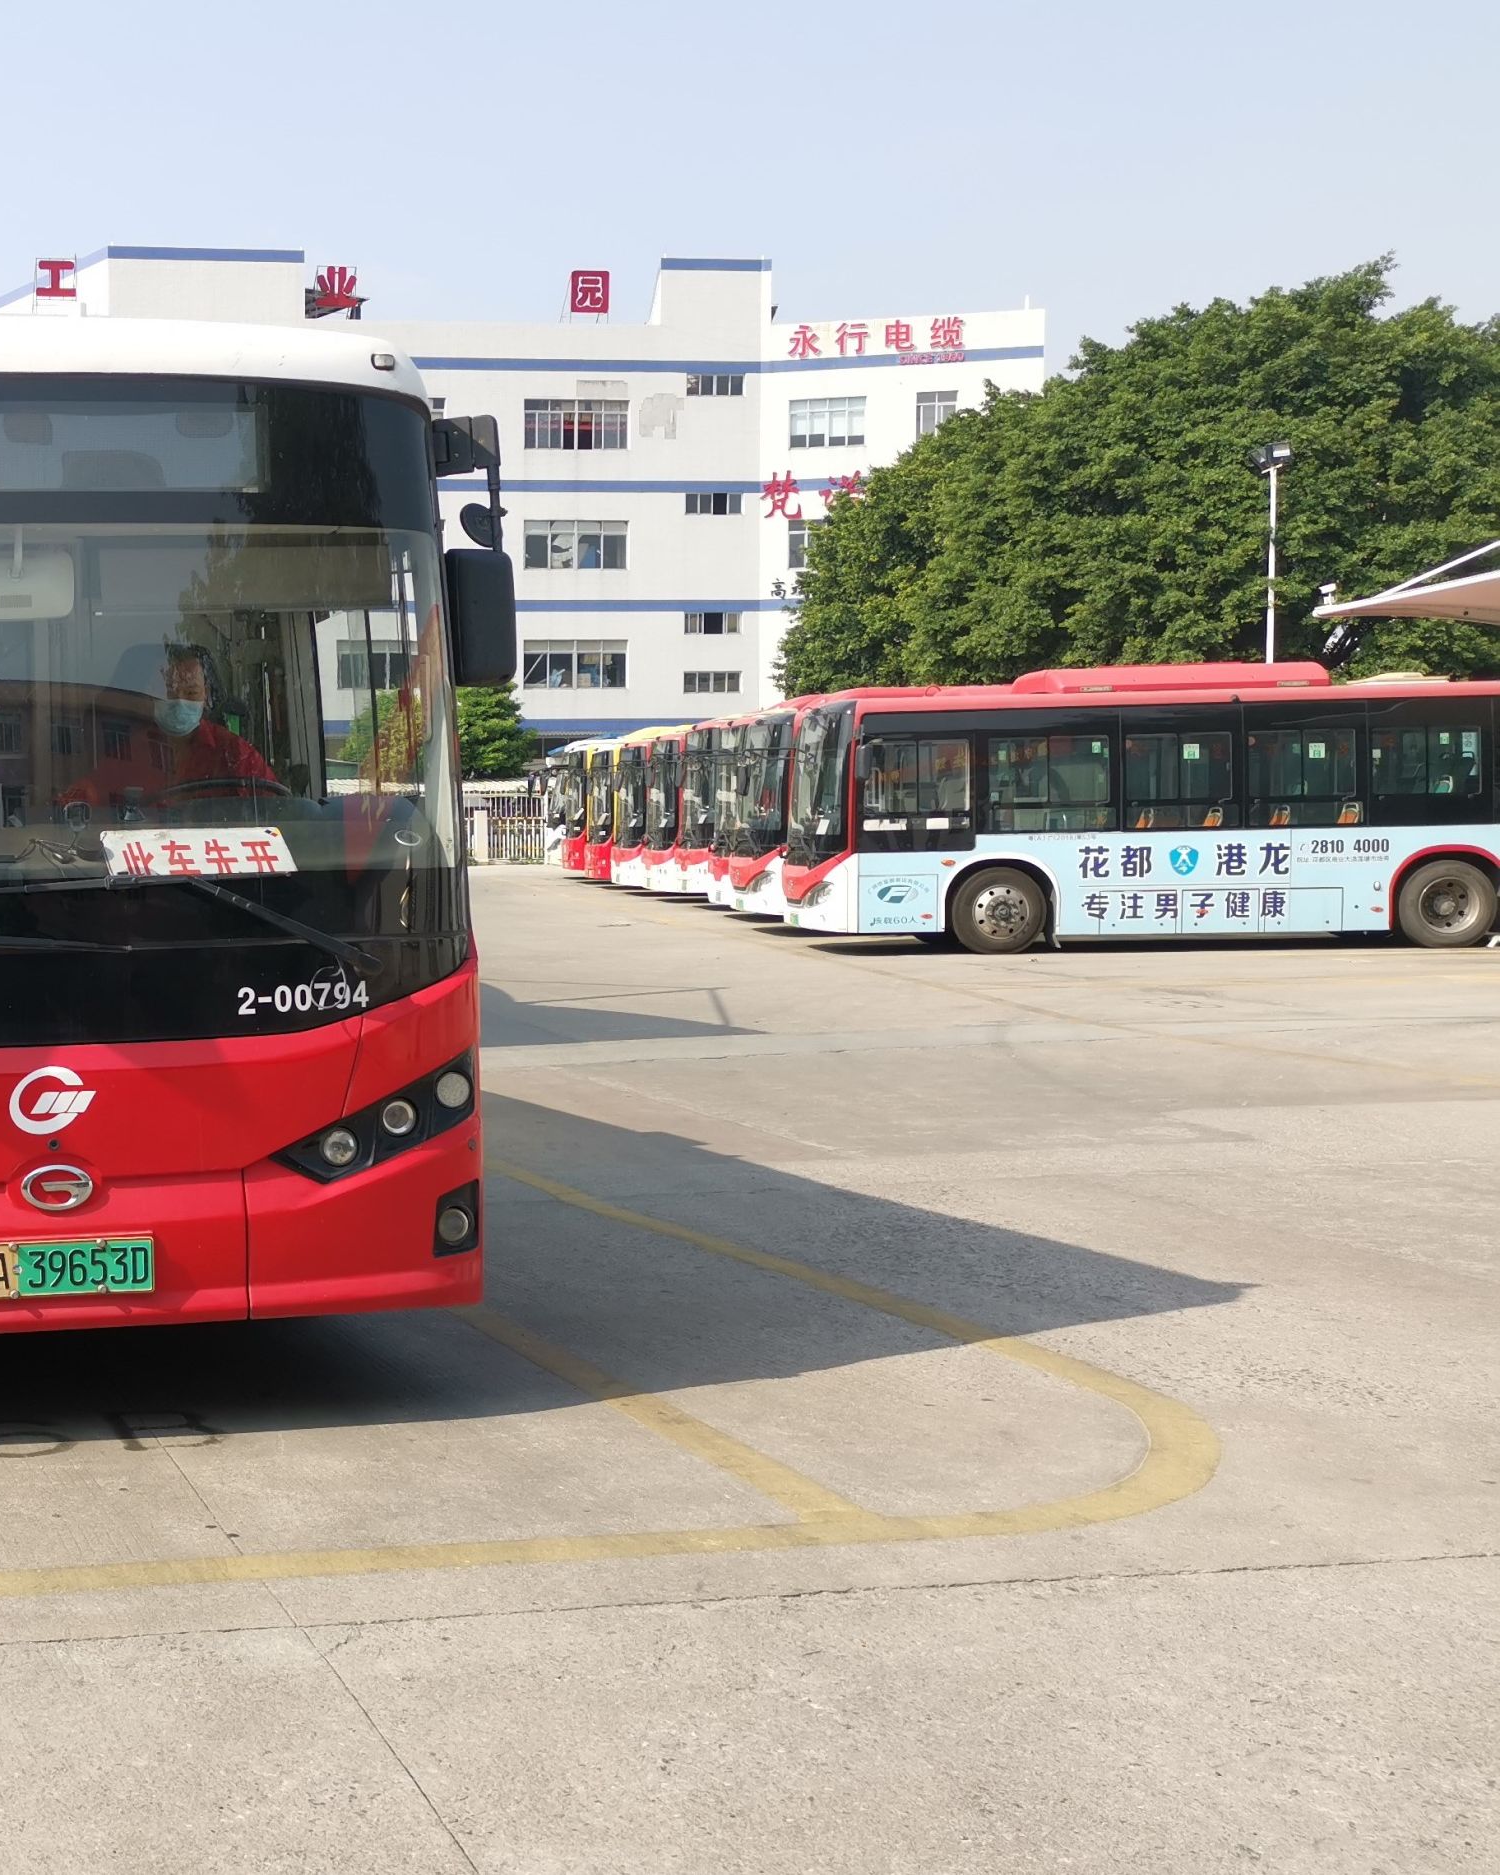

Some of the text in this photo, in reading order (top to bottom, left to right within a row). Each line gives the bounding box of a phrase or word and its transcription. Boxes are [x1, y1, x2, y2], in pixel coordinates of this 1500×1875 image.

[788, 317, 965, 358] 永行电缆
[121, 838, 279, 875] 此车先开
[1078, 842, 1290, 879] 花都 港龙
[1310, 838, 1390, 854] 2810 4000
[1081, 890, 1286, 920] 专注男子健康
[237, 980, 370, 1015] 2-00794
